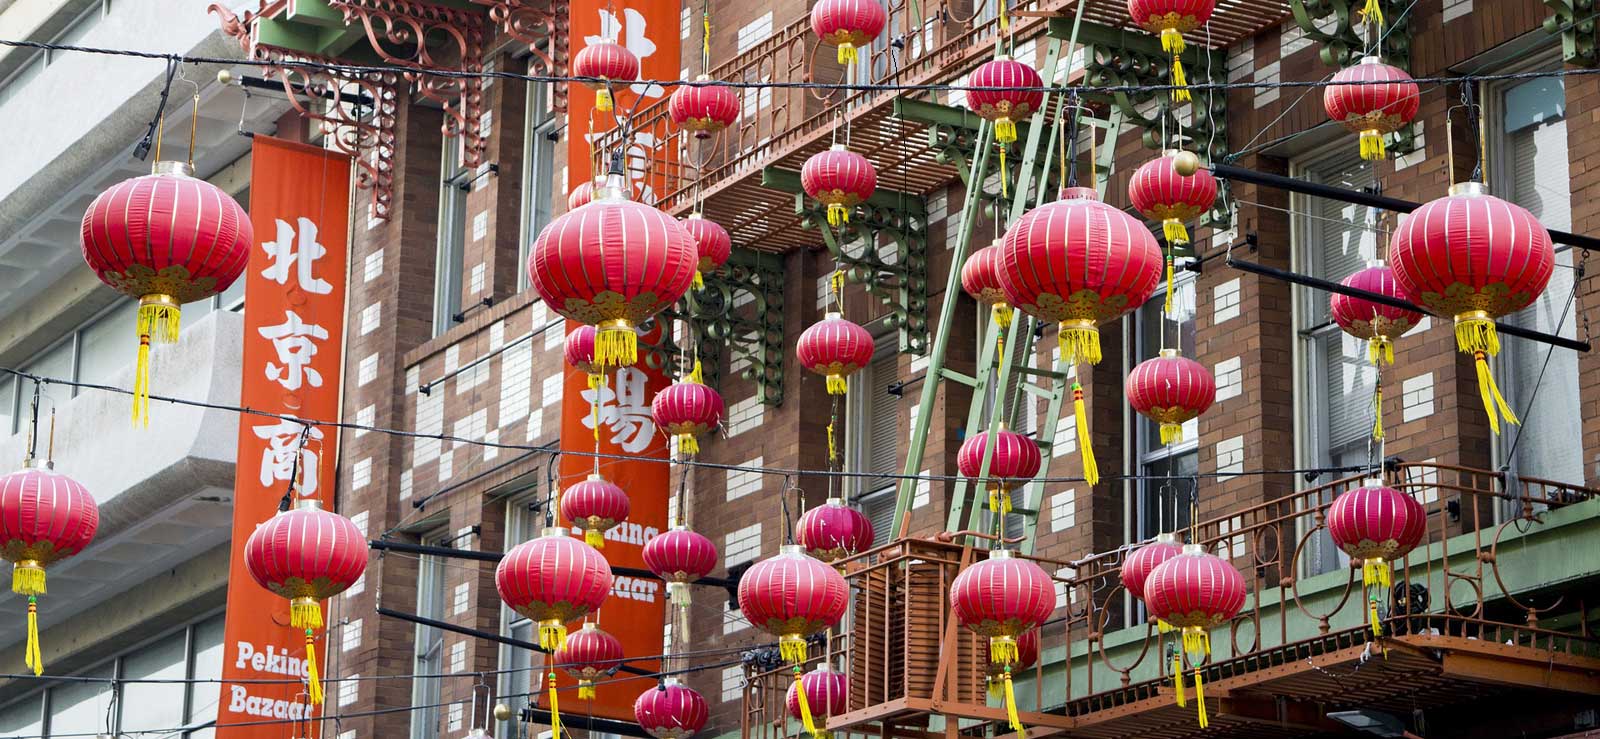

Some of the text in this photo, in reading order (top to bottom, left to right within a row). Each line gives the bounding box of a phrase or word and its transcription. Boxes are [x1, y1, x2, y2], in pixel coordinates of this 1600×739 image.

[251, 217, 334, 528] 北京商
[608, 575, 658, 603] aar
[229, 684, 313, 720] Bazaar
